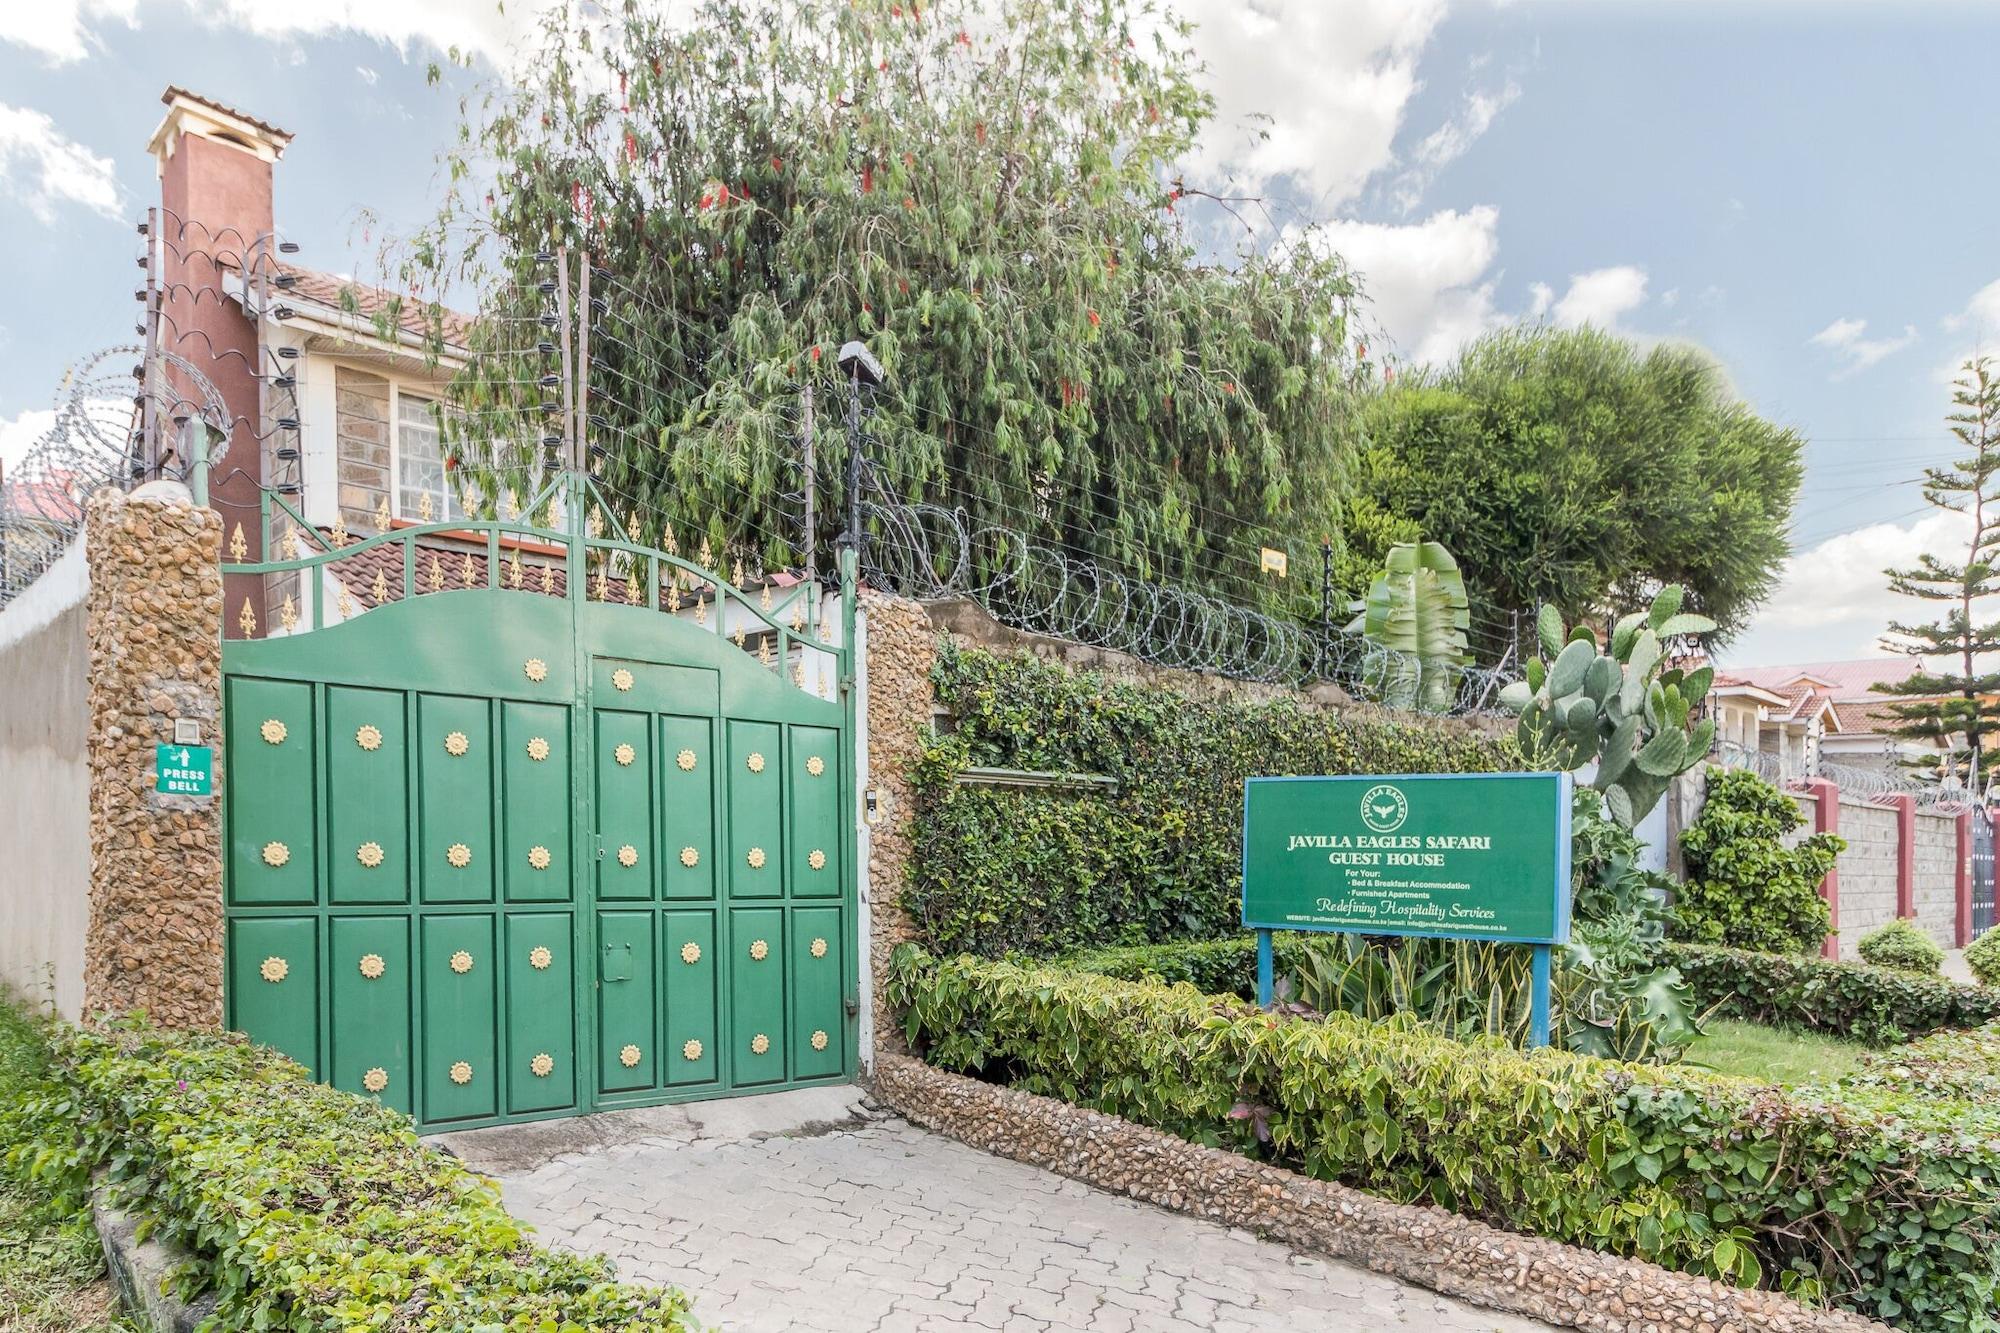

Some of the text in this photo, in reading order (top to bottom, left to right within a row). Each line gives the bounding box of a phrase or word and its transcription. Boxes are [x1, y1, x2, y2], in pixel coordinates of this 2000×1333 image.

[163, 768, 205, 780] PRESS
[168, 780, 200, 792] BELL
[1364, 788, 1404, 819] JAVILLA EAGLES
[1287, 836, 1490, 851] JAVILLA EAGLES SAFARI
[1328, 852, 1444, 866] GUEST HOUSE
[1345, 869, 1380, 878] For Your:
[1409, 881, 1470, 890] Accommodation
[1388, 890, 1430, 899] Apartments
[1316, 898, 1495, 920] Redefining Hospitality Services
